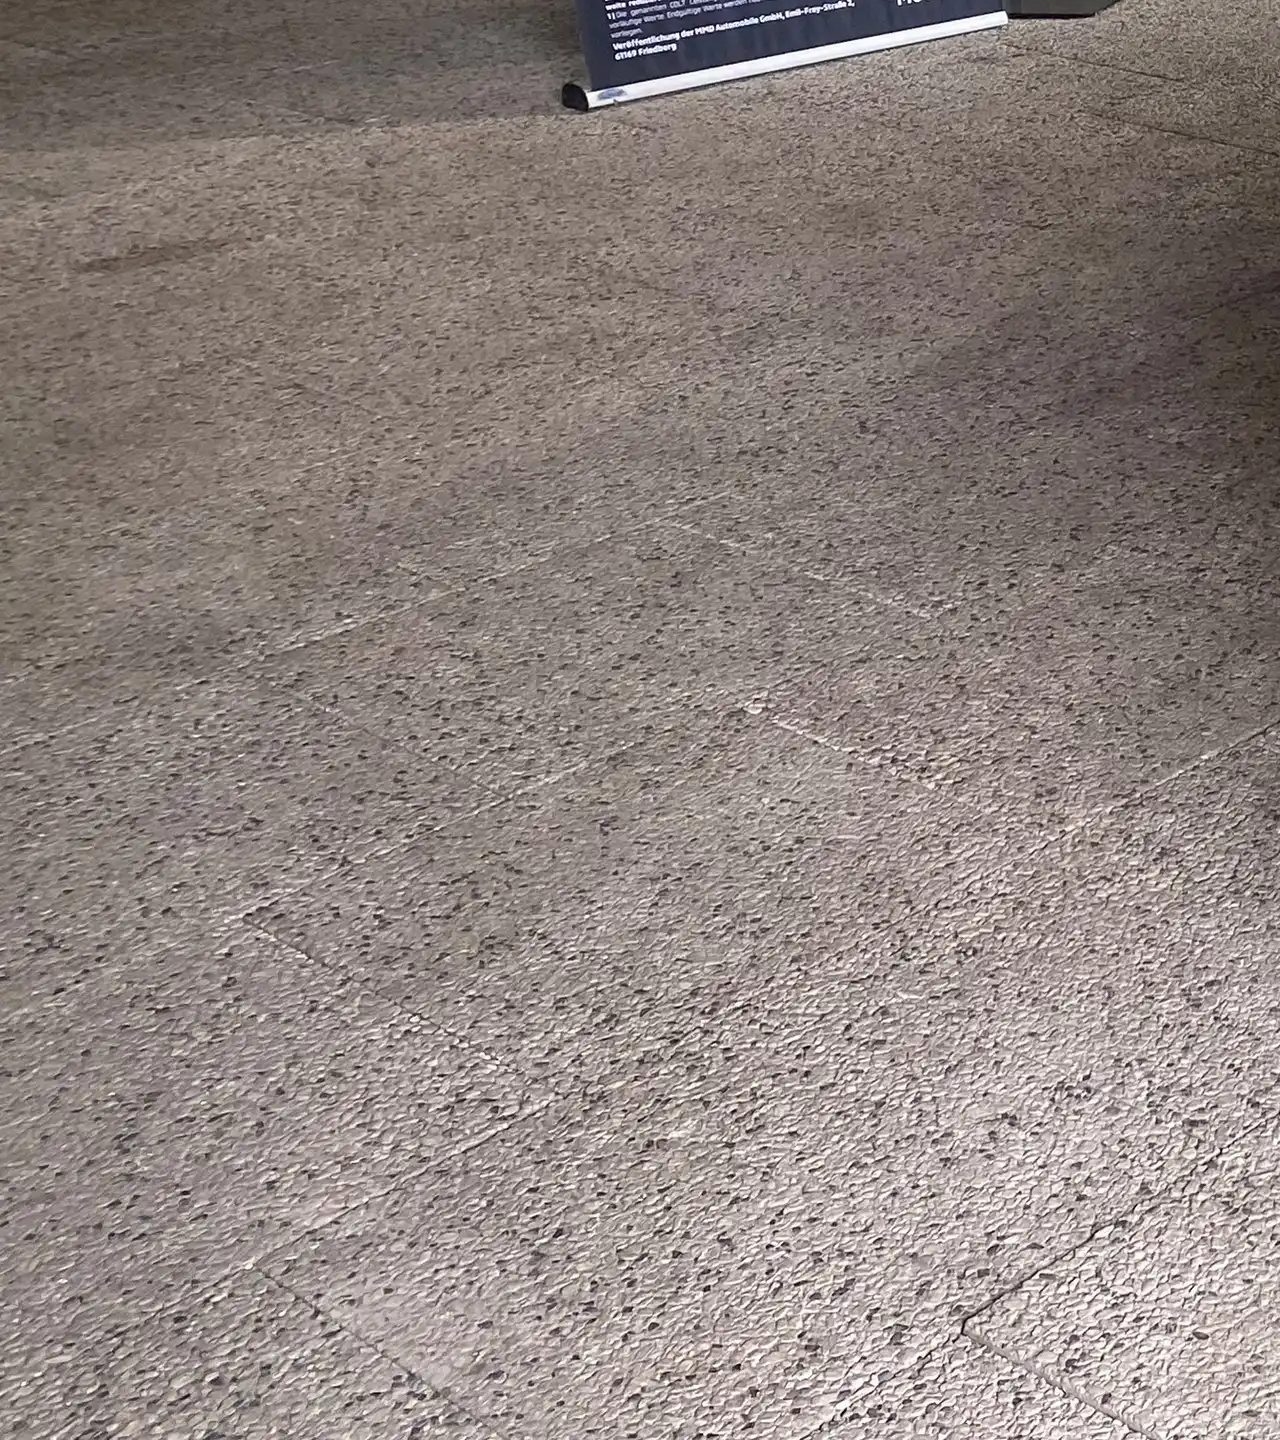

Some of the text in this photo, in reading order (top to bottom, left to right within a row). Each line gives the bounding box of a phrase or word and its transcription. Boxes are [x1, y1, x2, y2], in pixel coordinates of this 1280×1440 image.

[612, 31, 680, 50] Veröffentlichung
[680, 29, 694, 37] der
[614, 42, 677, 60] 61169 Friedberg
